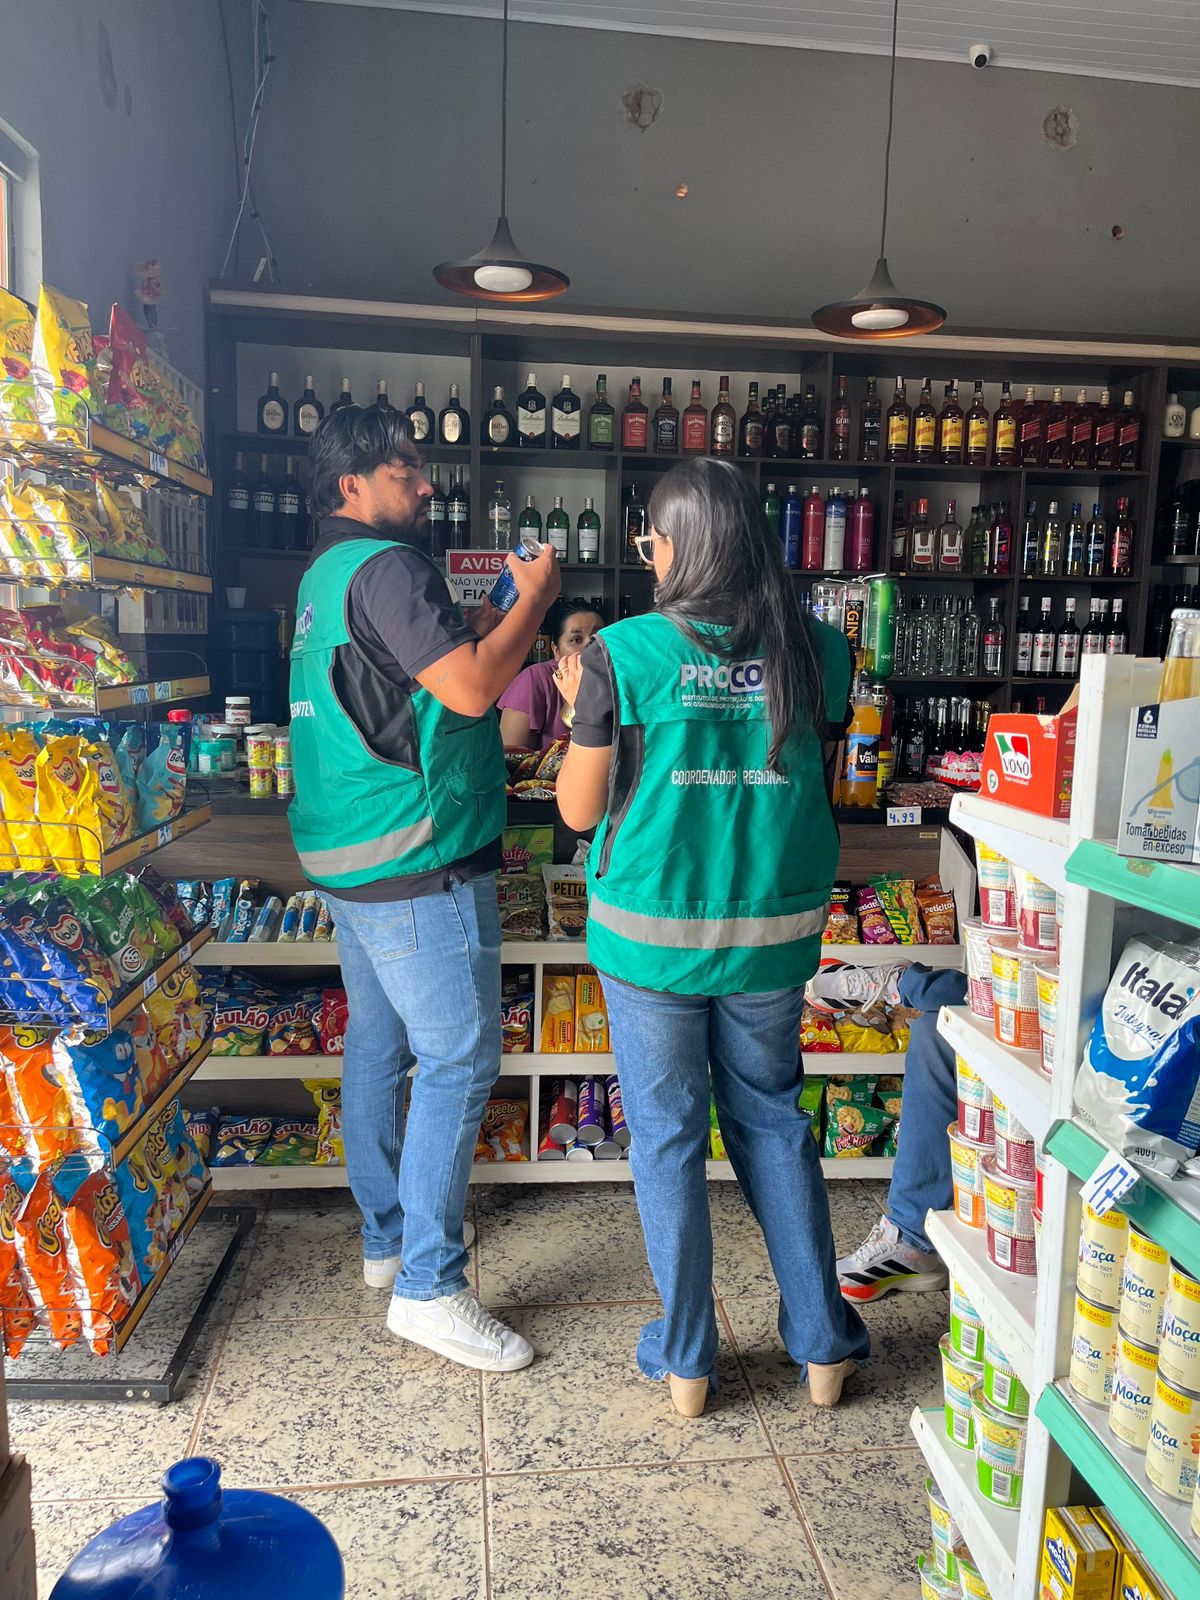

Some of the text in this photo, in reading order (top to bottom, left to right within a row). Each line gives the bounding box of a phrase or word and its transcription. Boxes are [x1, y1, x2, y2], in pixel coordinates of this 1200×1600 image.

[451, 578, 471, 586] NÃO
[463, 589, 487, 600] FIA
[846, 610, 859, 636] GIN
[680, 663, 763, 689] PROCO
[1143, 709, 1154, 724] 6
[671, 769, 737, 785] COORDENADOR
[1003, 757, 1030, 777] VONO
[889, 812, 915, 823] 4.99
[1126, 822, 1187, 841] Tomar bebidas
[503, 844, 536, 864] uffles
[1142, 840, 1185, 855] en exceso
[1120, 961, 1188, 1020] Itala
[213, 1006, 270, 1029] GULÃO
[500, 1006, 531, 1027] LÃO
[327, 1035, 345, 1052] CR
[218, 1118, 272, 1139] GULÃO
[1135, 1147, 1156, 1160] 400g
[1091, 1249, 1116, 1263] oça
[1124, 1276, 1156, 1299] Moça
[1165, 1320, 1200, 1343] Moça
[1116, 1380, 1152, 1405] Moça
[1151, 1421, 1179, 1449] Moça
